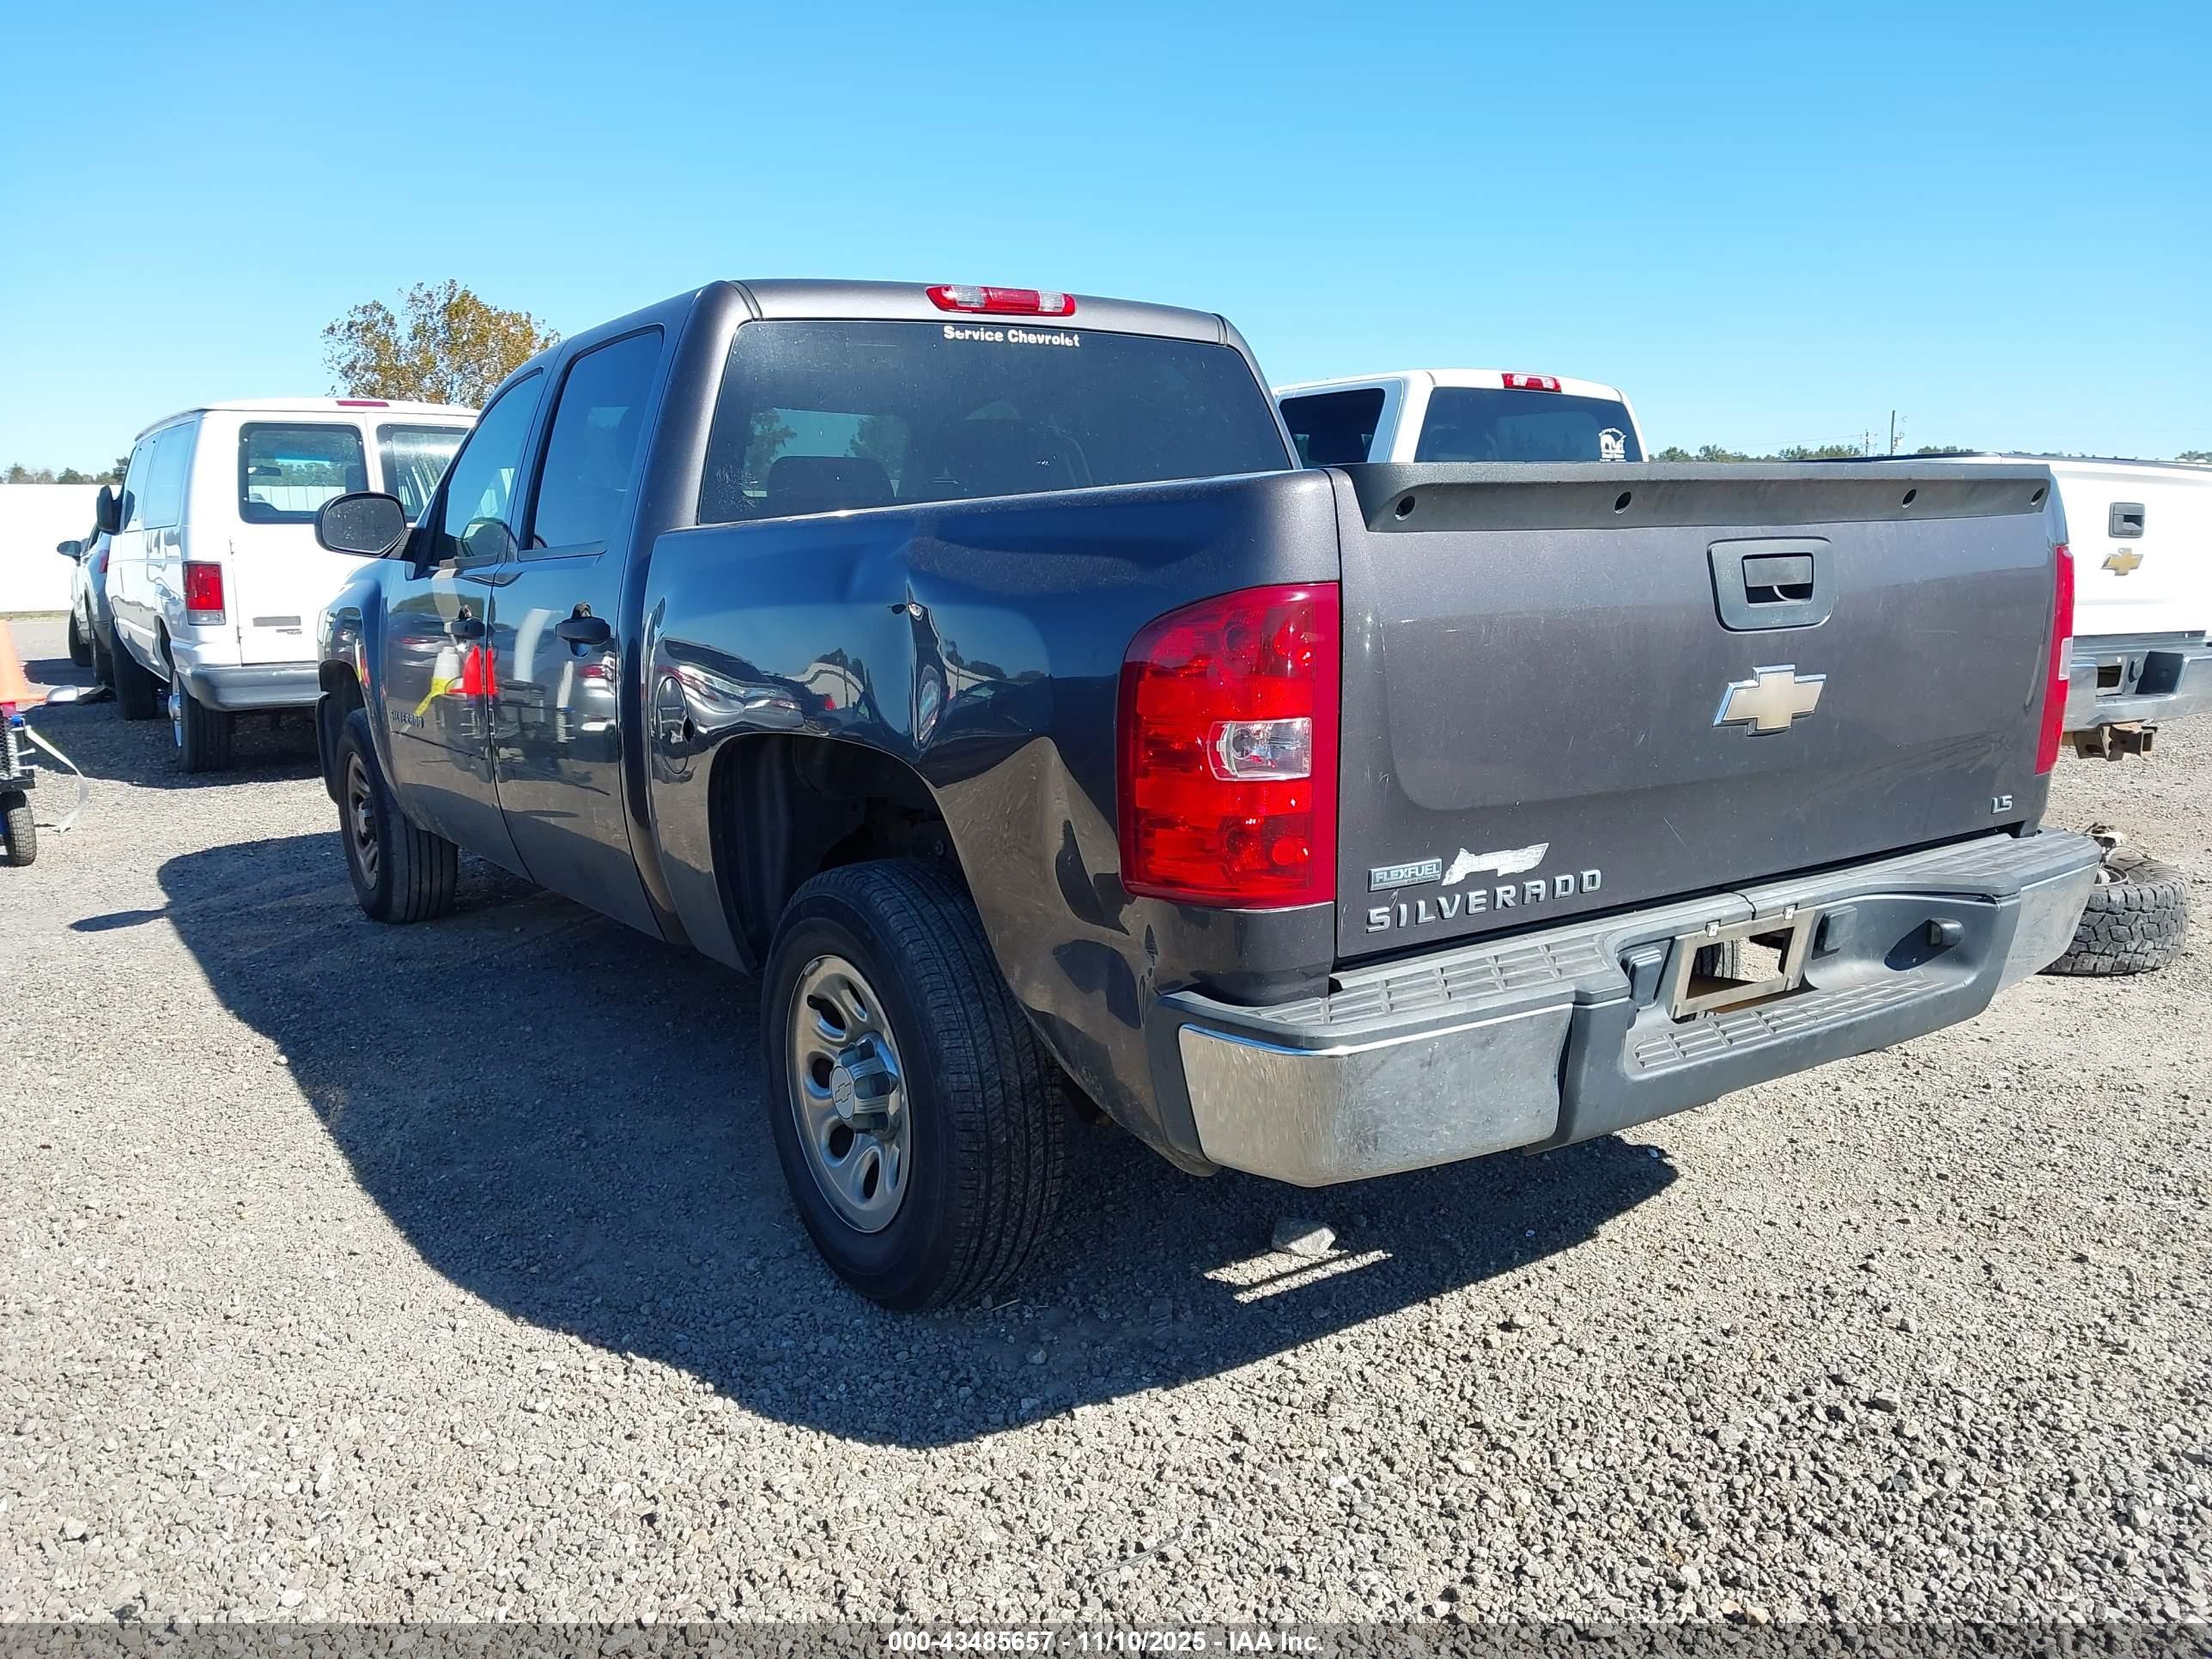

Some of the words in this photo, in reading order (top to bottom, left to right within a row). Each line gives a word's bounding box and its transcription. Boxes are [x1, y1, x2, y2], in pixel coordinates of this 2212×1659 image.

[944, 325, 1004, 342] Service
[1007, 329, 1080, 347] Chevrolet
[1992, 794, 2013, 814] LS
[1375, 863, 1440, 883] FLEXFUEL
[1366, 869, 1601, 933] SILVERADO
